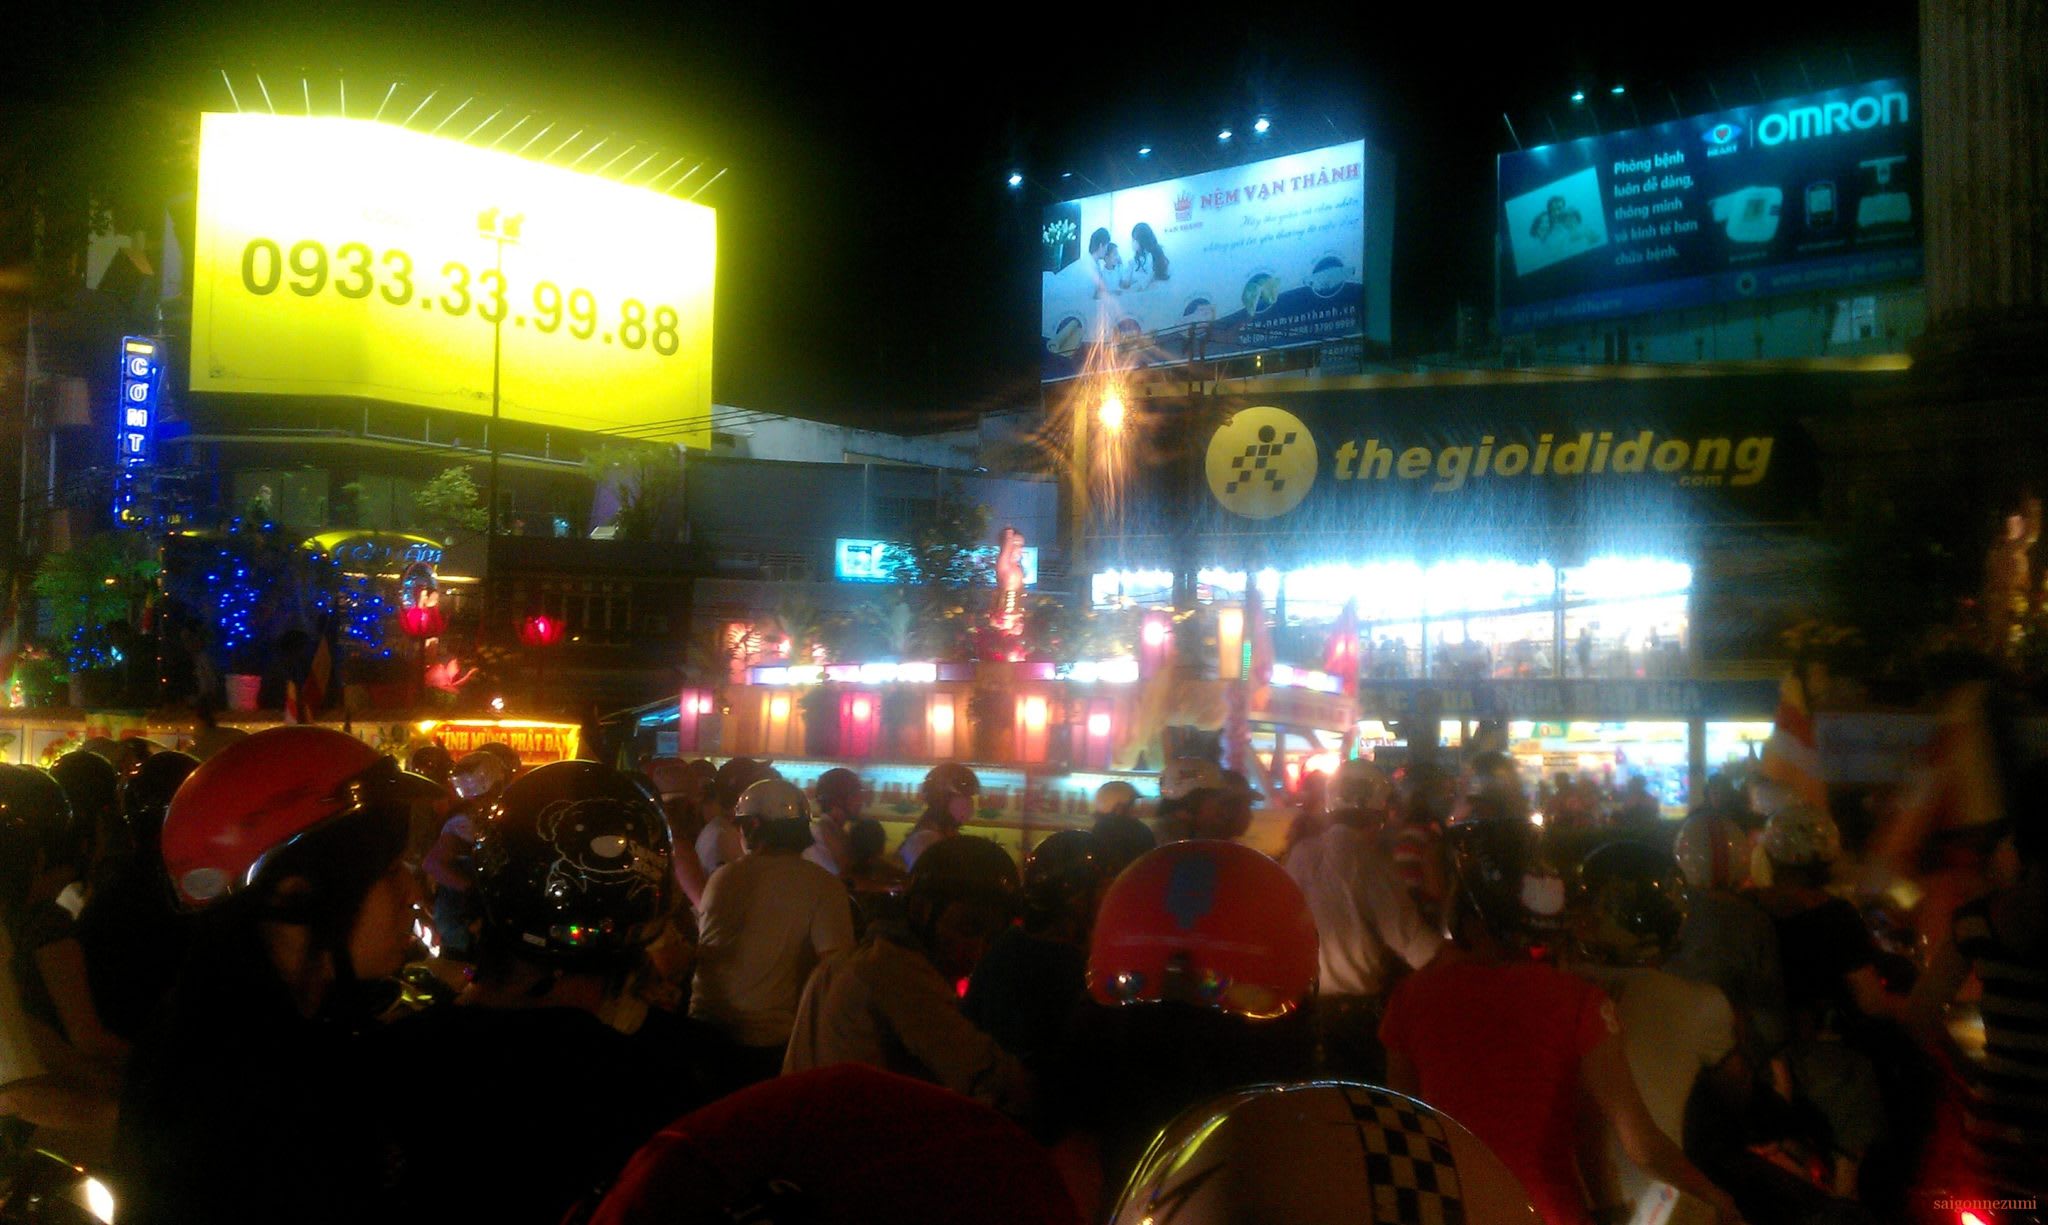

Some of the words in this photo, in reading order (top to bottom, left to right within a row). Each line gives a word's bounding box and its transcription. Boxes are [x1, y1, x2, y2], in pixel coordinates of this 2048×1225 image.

[1758, 92, 1908, 145] OMRON
[1614, 160, 1651, 174] Phòng
[1655, 150, 1684, 168] bệnh
[1244, 179, 1285, 200] VẠN
[1614, 183, 1640, 197] luôn
[1615, 205, 1649, 219] thông
[1652, 197, 1682, 214] minh
[241, 238, 679, 356] 0933.33.99.88
[1334, 431, 1775, 492] thegioididong
